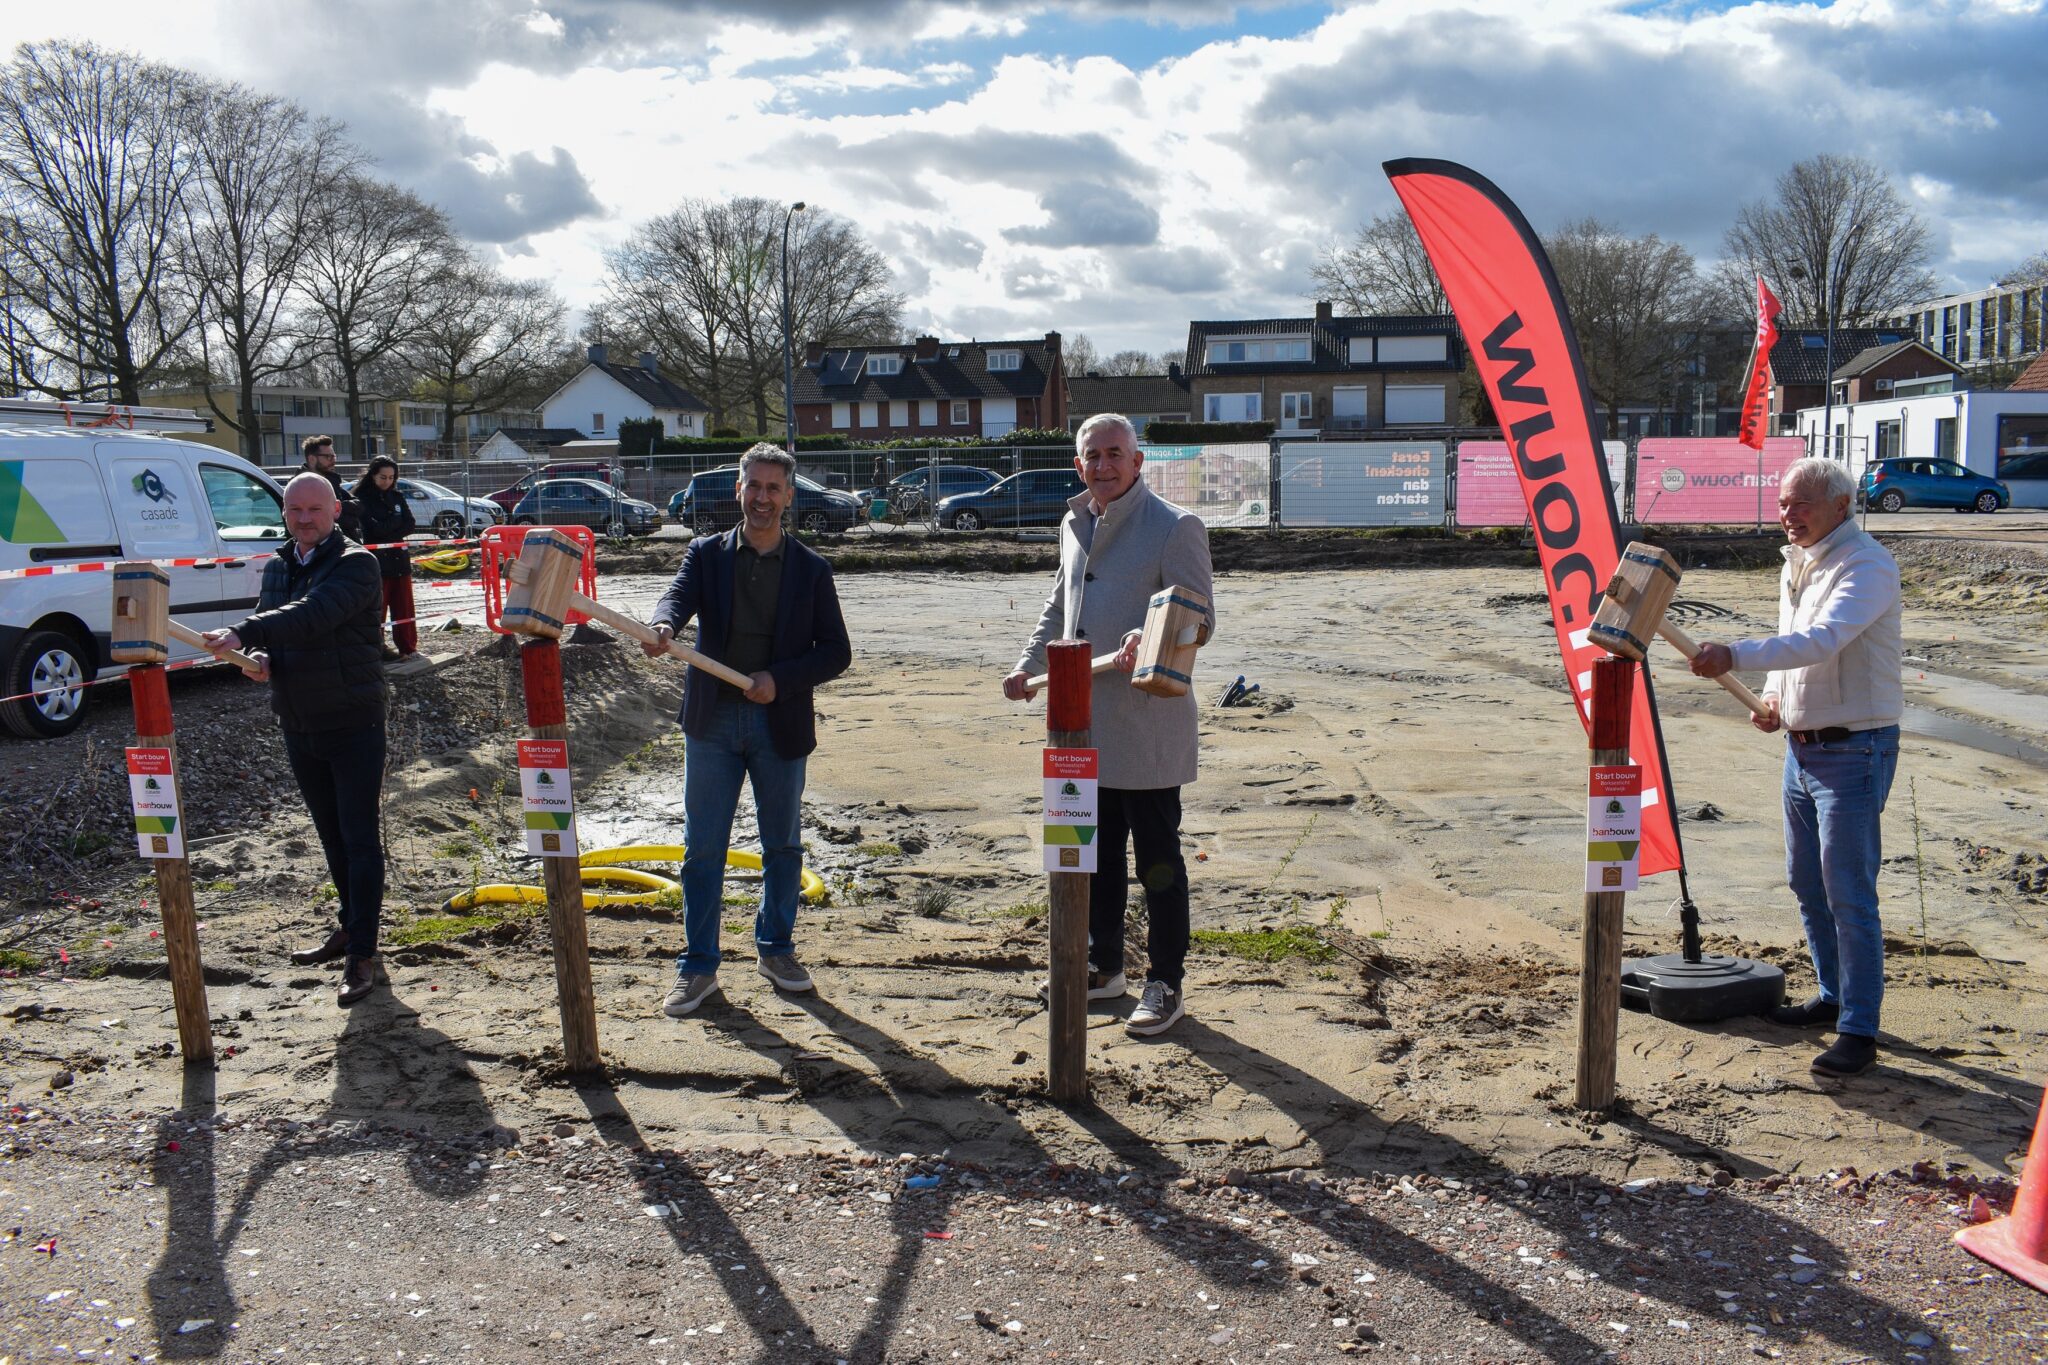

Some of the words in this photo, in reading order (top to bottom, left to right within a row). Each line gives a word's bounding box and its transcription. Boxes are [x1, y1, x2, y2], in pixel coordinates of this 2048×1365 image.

[141, 507, 178, 520] casade
[1049, 754, 1069, 762] Start
[1070, 754, 1092, 762] bouw
[1596, 772, 1615, 780] Start
[1616, 772, 1636, 780] bouw
[528, 797, 566, 806] banbouw
[1048, 809, 1092, 818] banbouw
[1593, 828, 1636, 836] banbouw
